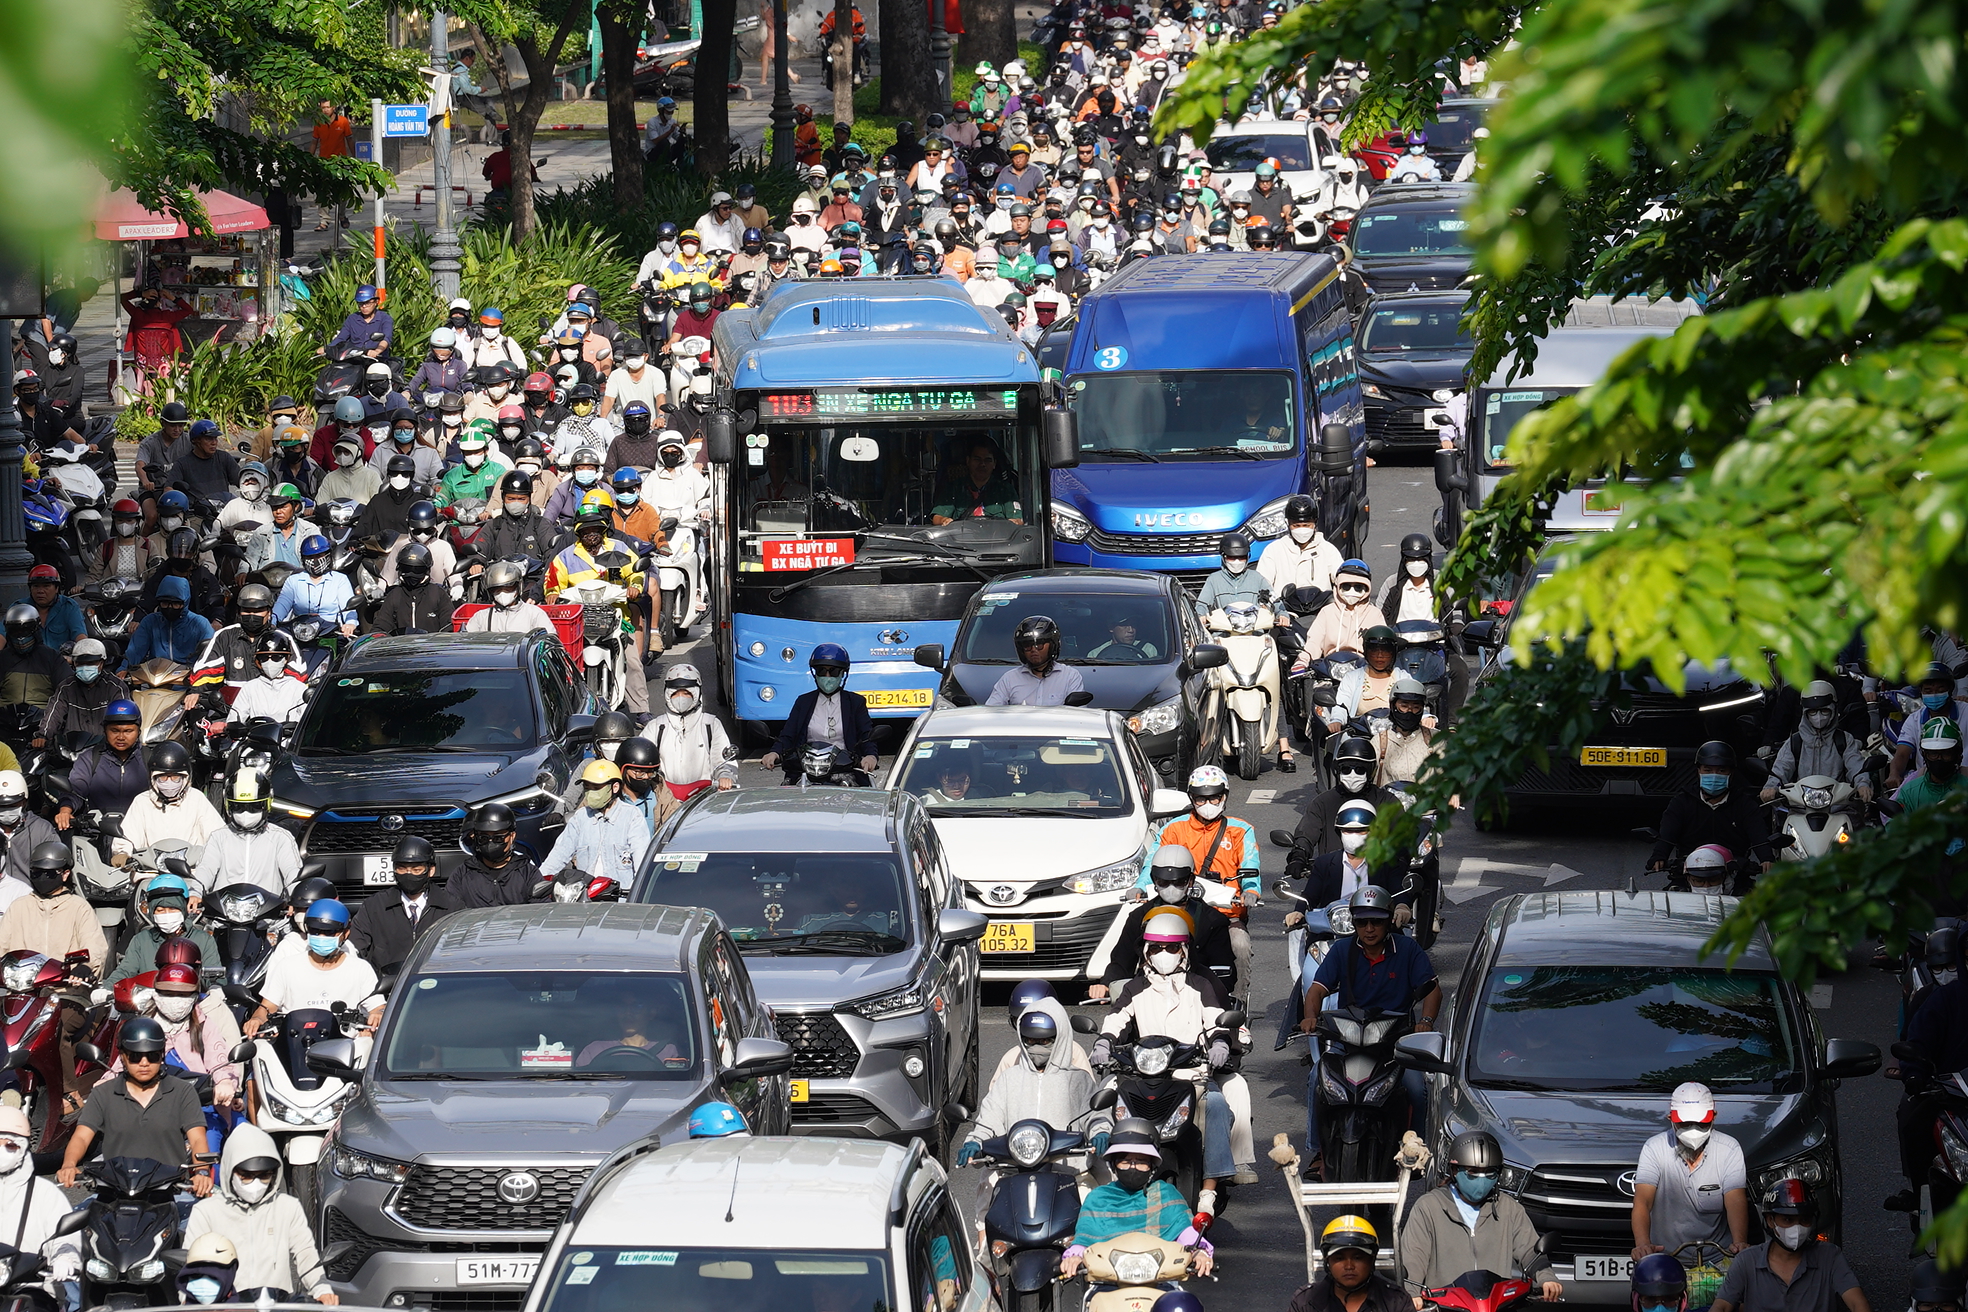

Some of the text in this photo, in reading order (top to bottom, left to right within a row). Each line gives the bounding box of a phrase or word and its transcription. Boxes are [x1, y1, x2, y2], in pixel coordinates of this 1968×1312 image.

[395, 108, 417, 117] ĐƯỜNG
[388, 119, 404, 131] HOÀNG
[405, 120, 414, 131] VĂN
[143, 226, 175, 234] LEADERS
[1101, 347, 1121, 369] 3
[768, 394, 812, 415] 103
[1135, 512, 1204, 527] IVECO
[779, 541, 837, 554] XE BUÝT ĐI
[772, 557, 787, 569] BX
[789, 555, 812, 569] NGÃ
[815, 556, 829, 568] TƯ
[1588, 750, 1660, 763] 50E-911.60
[990, 924, 1016, 937] 76A
[981, 938, 1028, 951] 105.32
[651, 1253, 675, 1262] ĐỒNG
